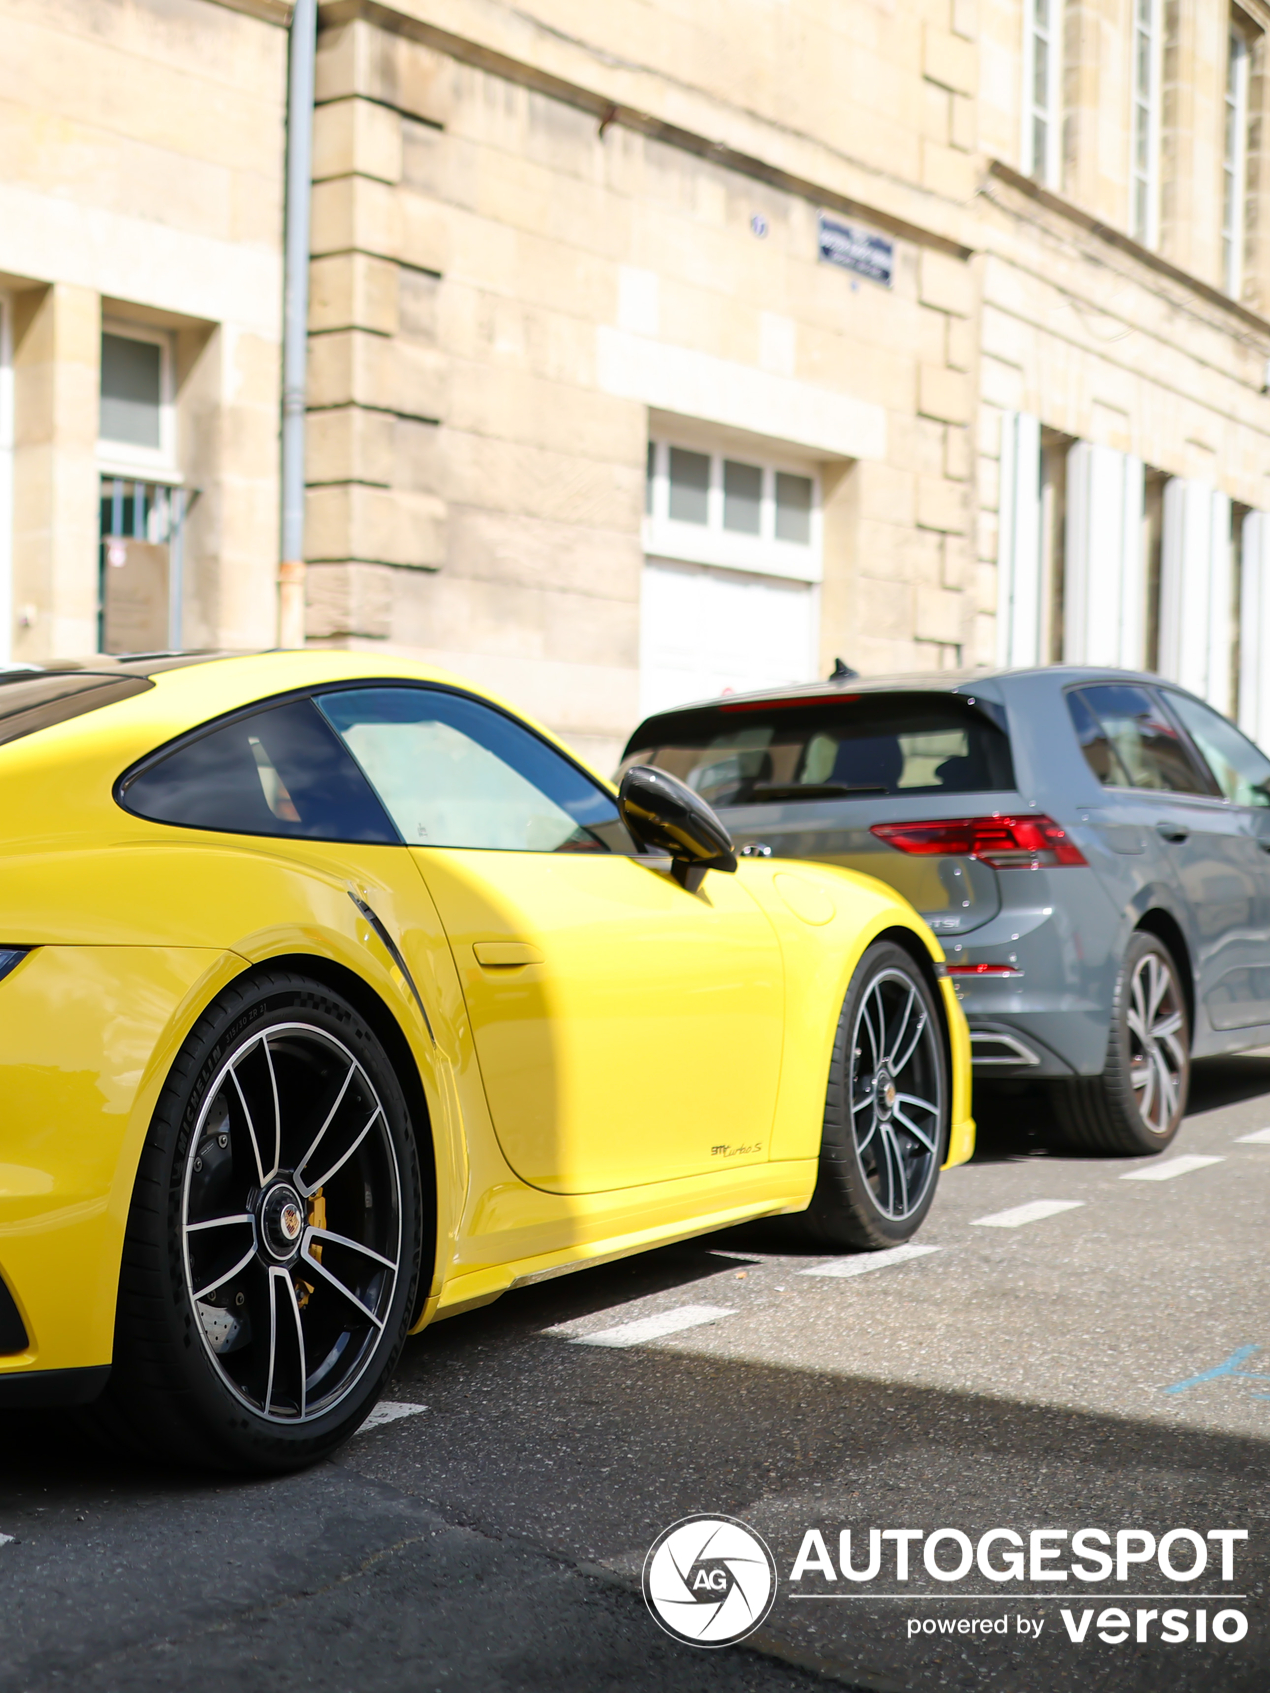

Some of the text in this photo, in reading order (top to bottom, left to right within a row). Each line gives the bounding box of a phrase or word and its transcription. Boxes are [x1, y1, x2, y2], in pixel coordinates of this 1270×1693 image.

[225, 1003, 267, 1043] 315/30 ZR 21
[177, 1044, 222, 1155] MICHELIN
